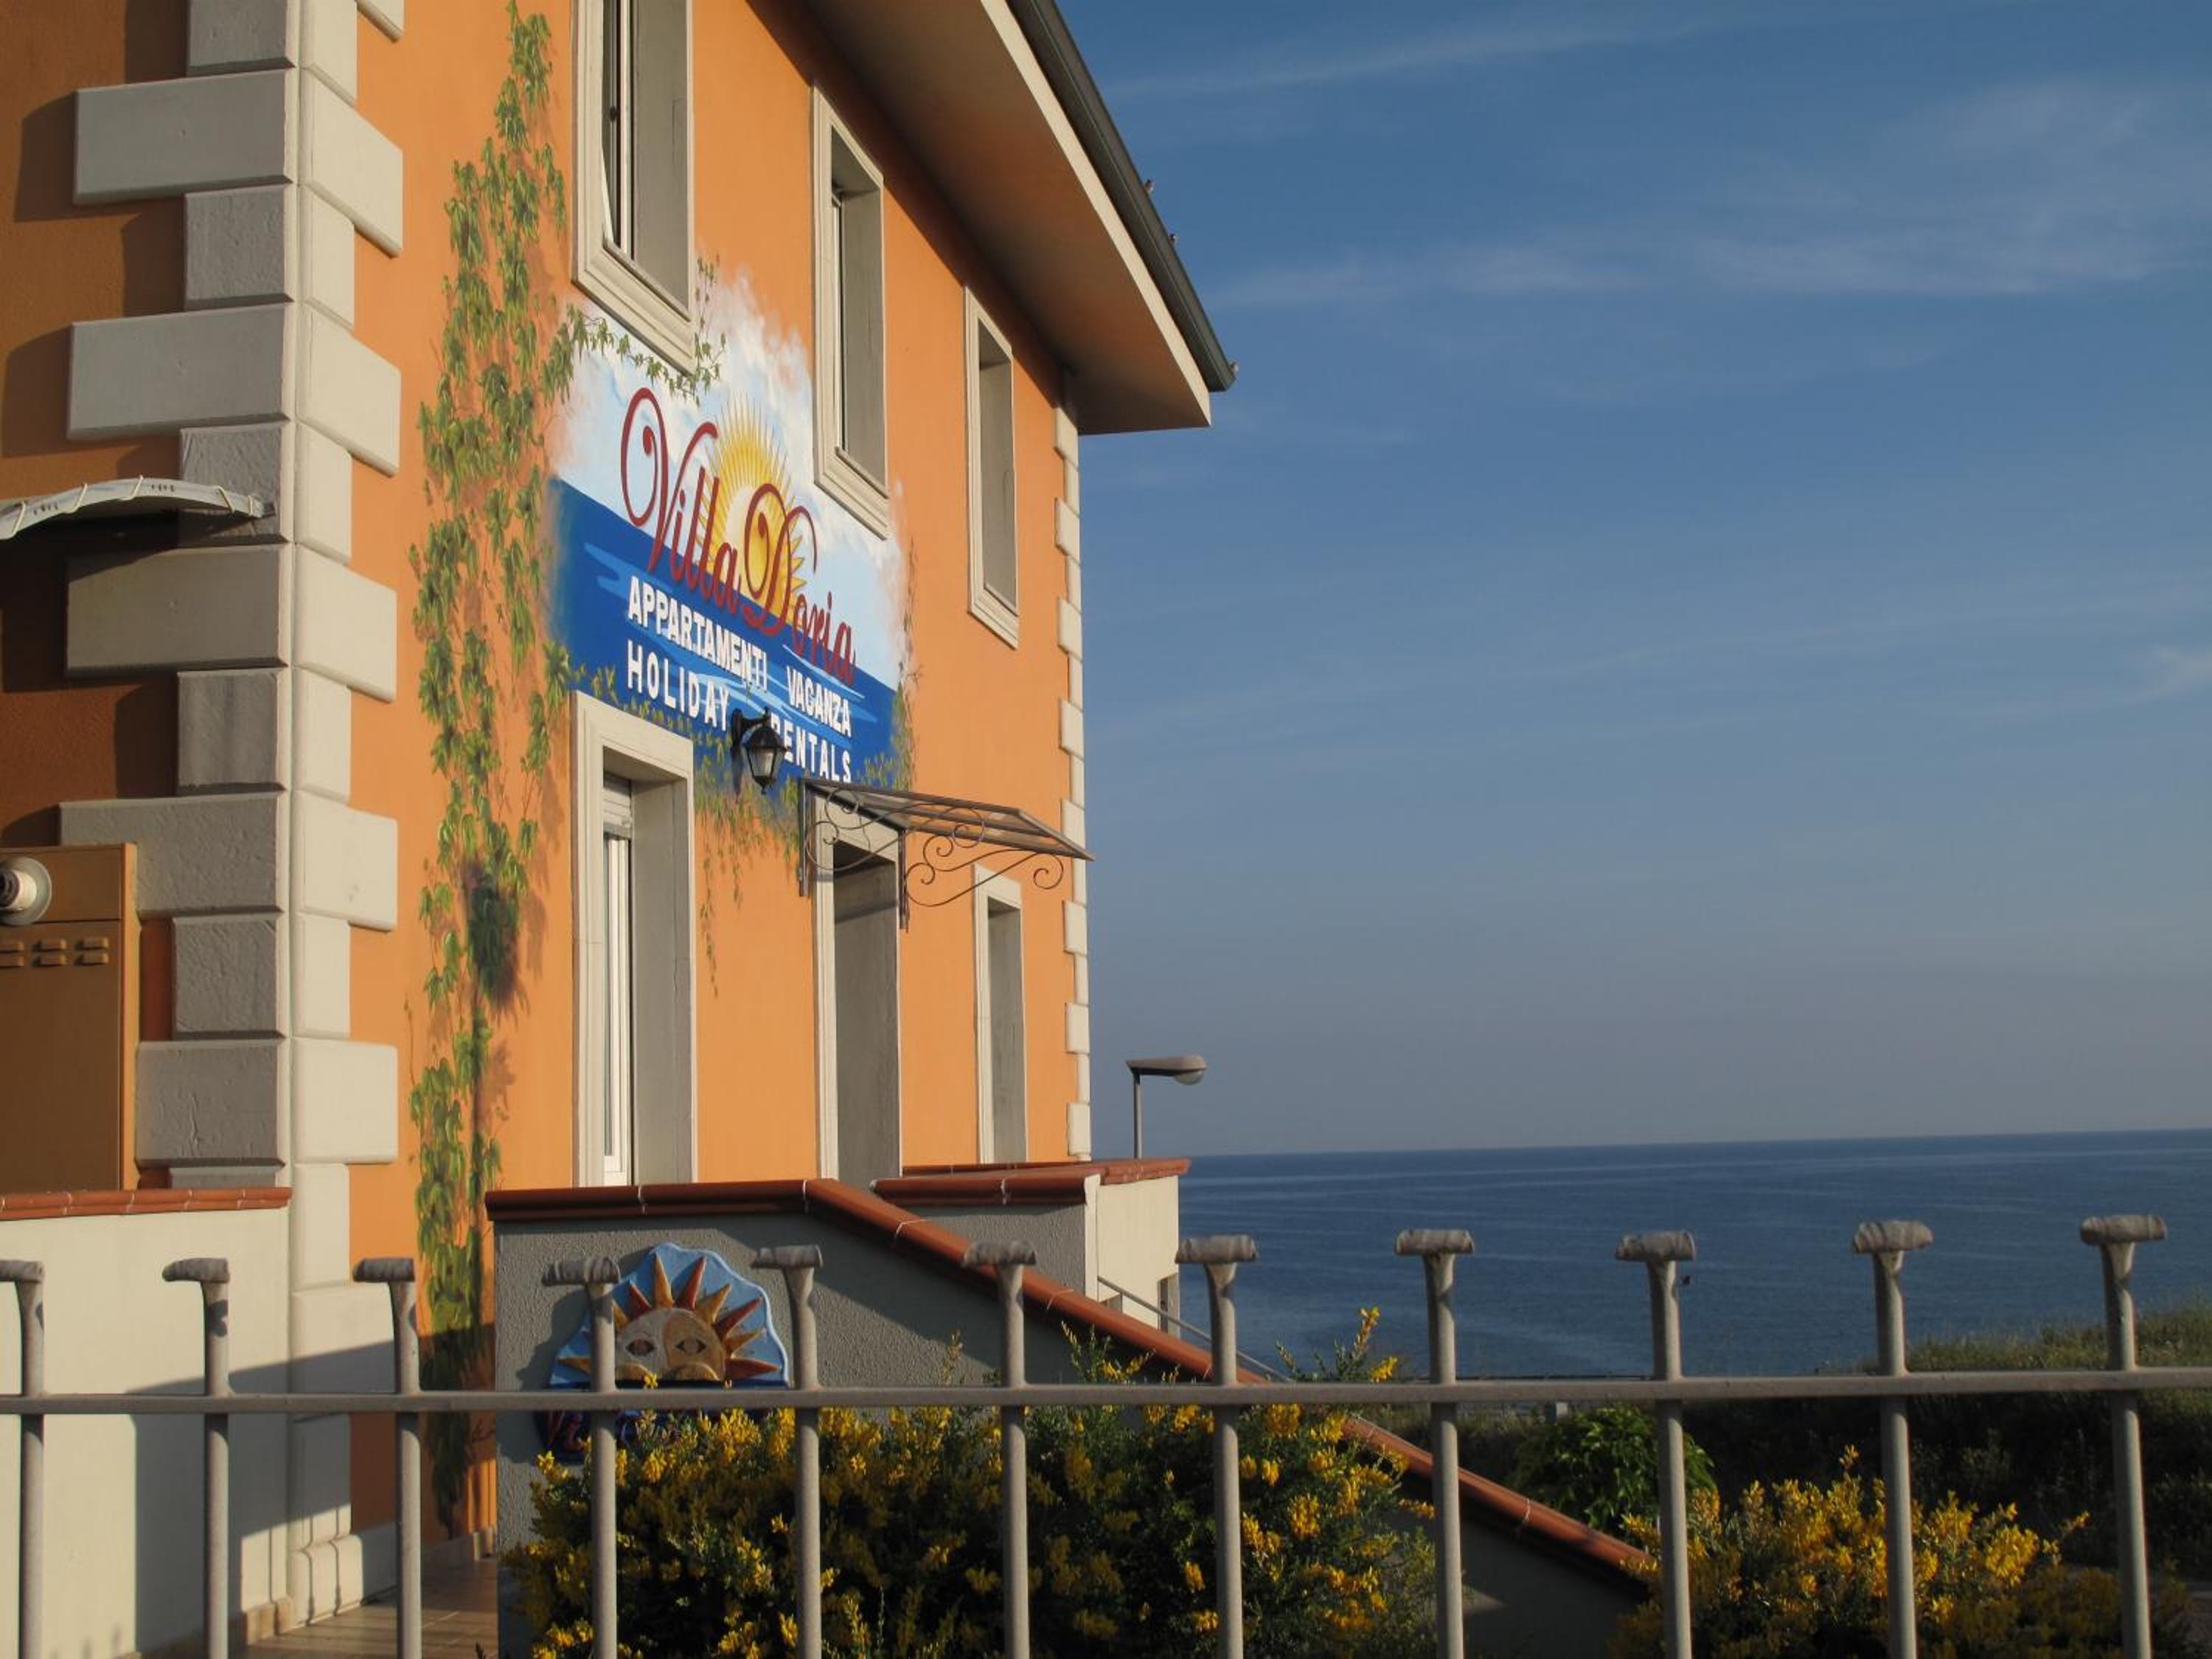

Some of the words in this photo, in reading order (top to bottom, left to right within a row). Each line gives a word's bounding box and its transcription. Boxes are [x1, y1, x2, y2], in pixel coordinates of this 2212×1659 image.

[622, 387, 742, 616] Villa
[744, 483, 855, 684] Doria
[627, 576, 768, 693] APPARTAMENTI
[627, 639, 730, 732] HOLIDAY
